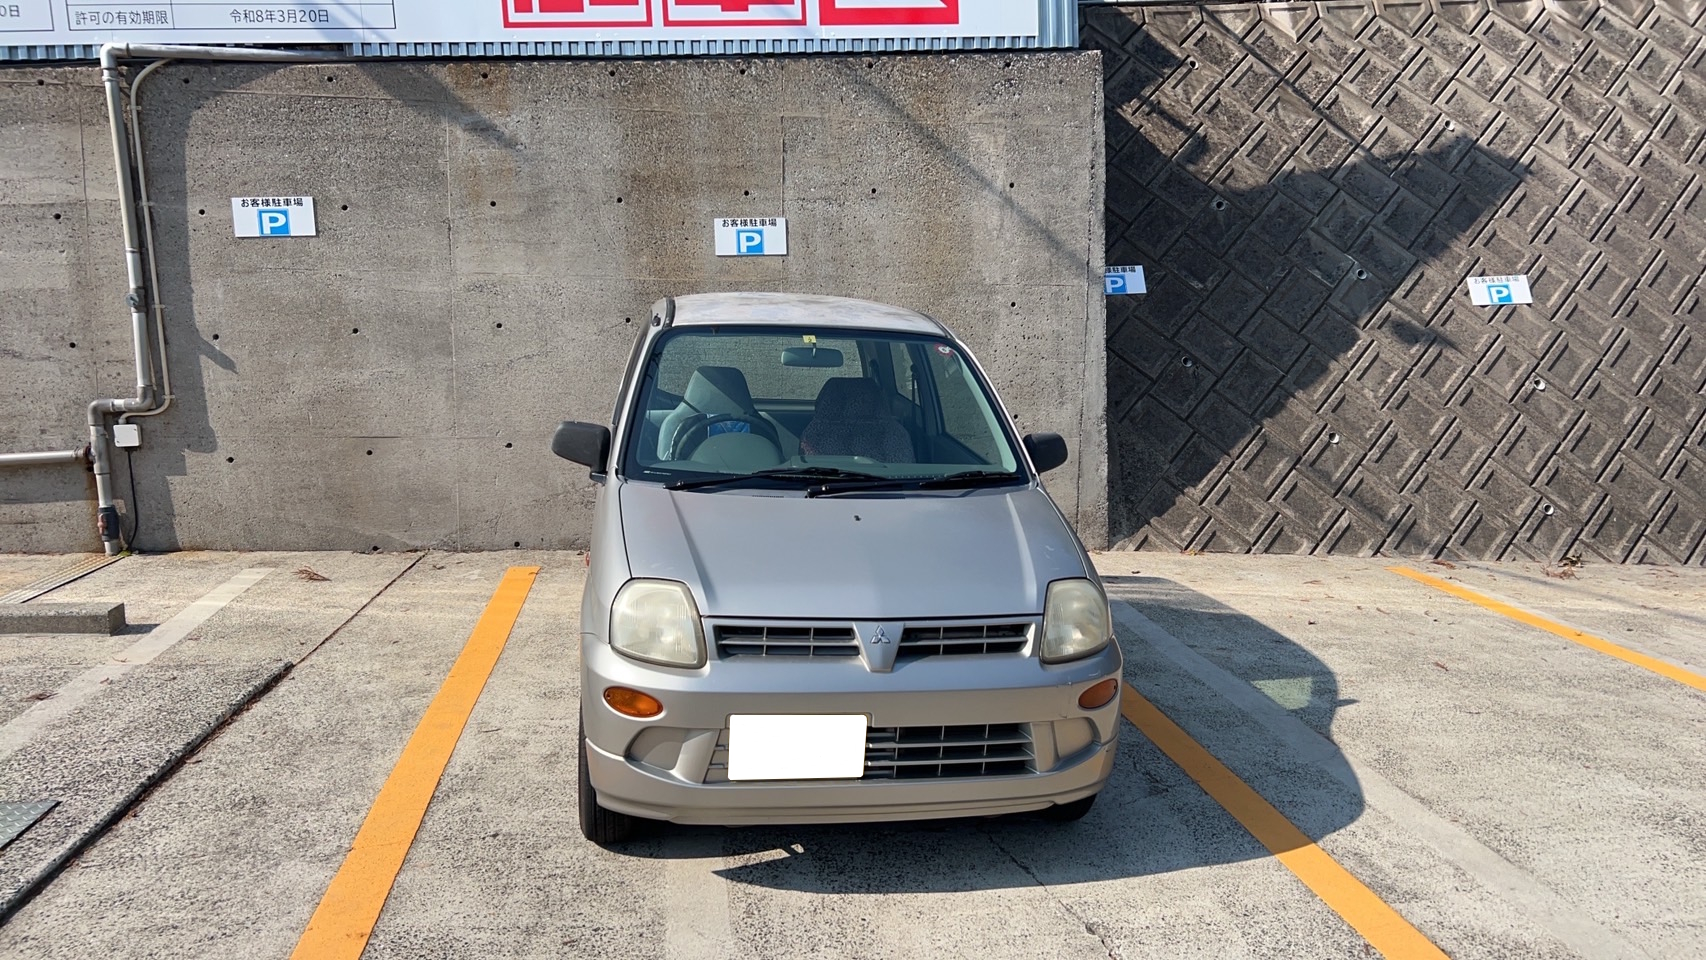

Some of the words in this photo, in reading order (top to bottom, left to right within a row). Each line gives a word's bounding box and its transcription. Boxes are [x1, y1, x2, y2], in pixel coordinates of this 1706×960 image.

[75, 11, 169, 25] 許可の有効期限
[230, 9, 329, 23] 令和8年3月20日
[241, 198, 303, 207] お客様駐車場
[261, 212, 286, 234] P
[722, 218, 777, 227] お客様駐車場
[740, 232, 761, 252] P
[1105, 277, 1123, 292] P
[1490, 287, 1508, 302] P
